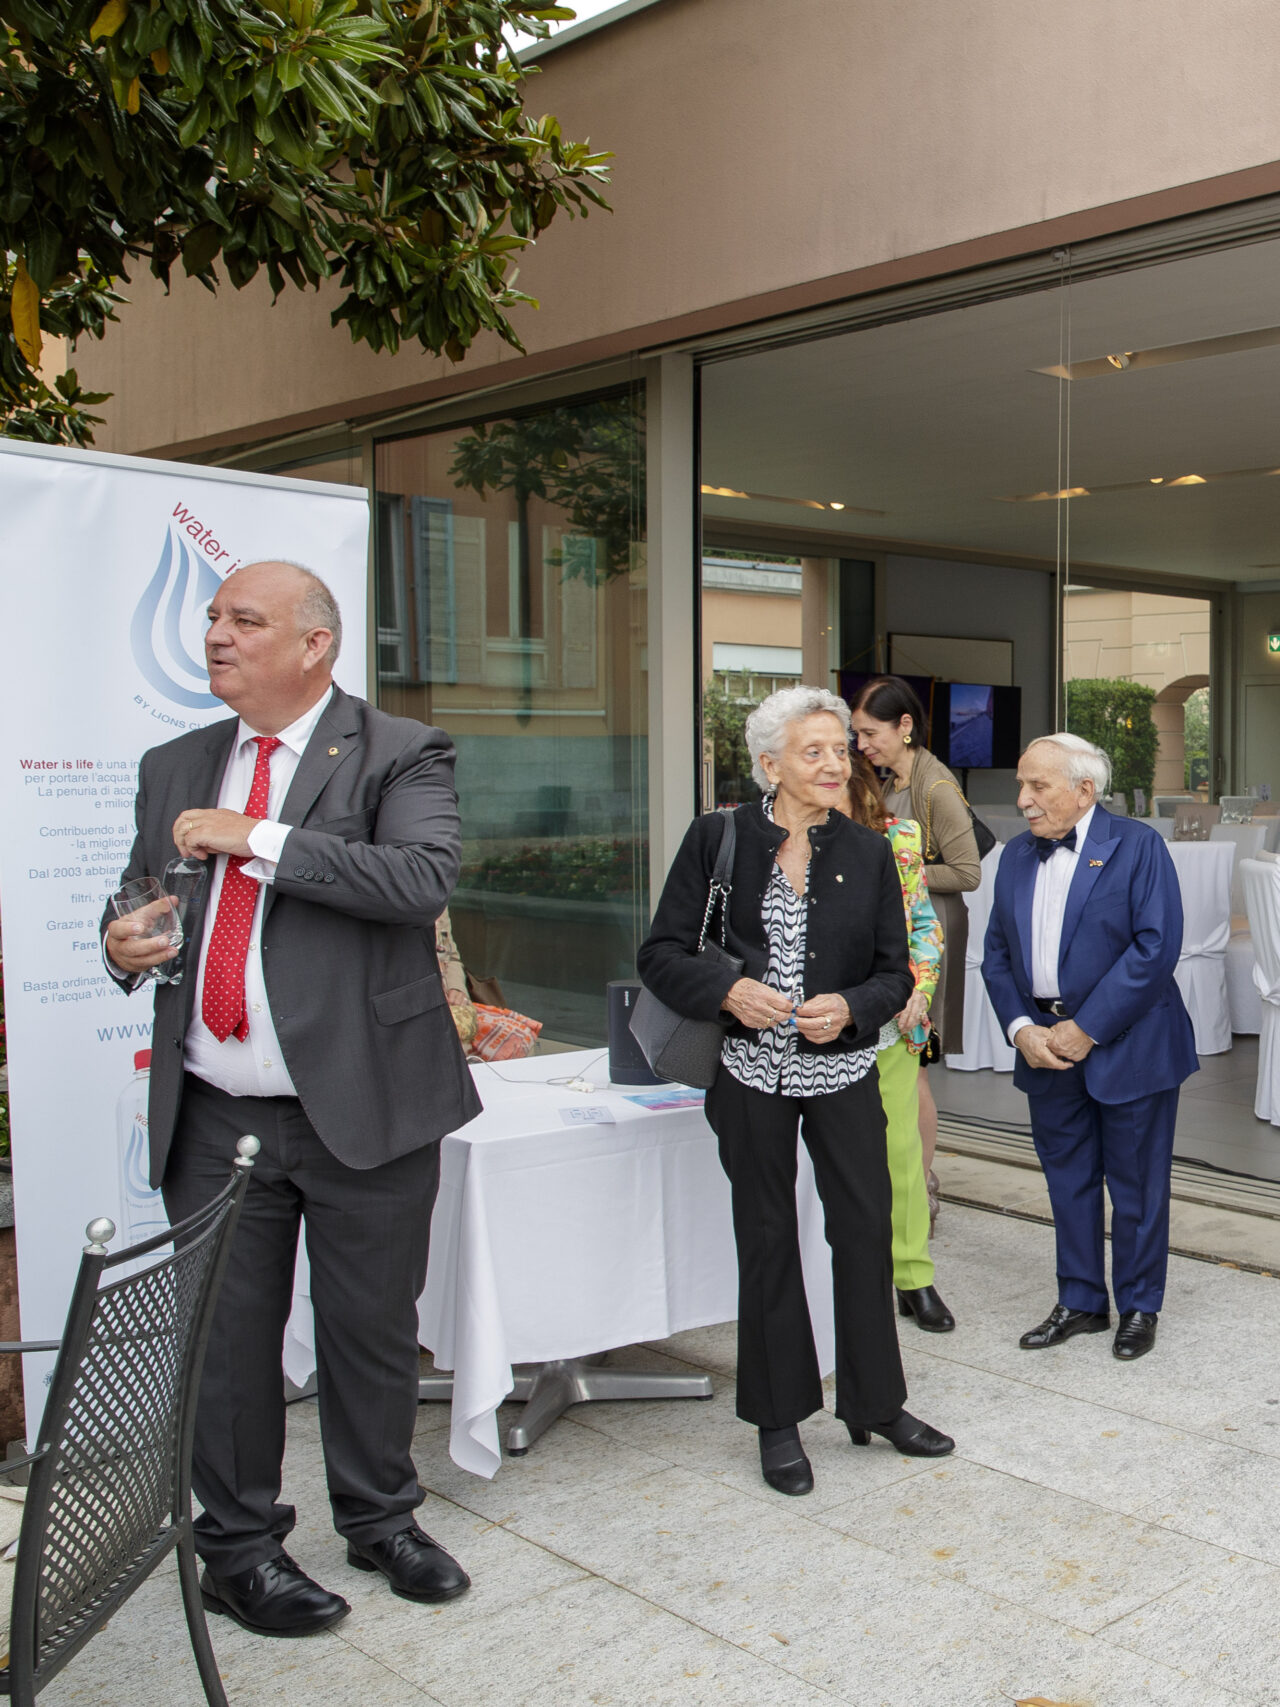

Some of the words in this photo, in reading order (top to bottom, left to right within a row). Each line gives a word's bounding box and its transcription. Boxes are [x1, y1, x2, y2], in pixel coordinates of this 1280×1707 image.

[172, 501, 230, 561] water
[134, 694, 150, 709] BY
[151, 708, 186, 729] LIONS
[20, 759, 58, 770] Water
[62, 759, 73, 770] is
[76, 759, 94, 770] life
[106, 761, 127, 769] una
[24, 775, 45, 786] per
[49, 774, 89, 785] portare
[38, 786, 53, 797] La
[56, 786, 98, 799] penuria
[101, 785, 110, 796] di
[94, 801, 102, 809] e
[39, 826, 115, 837] Contribuendo
[118, 824, 128, 835] al
[89, 837, 132, 850] migliore
[28, 869, 50, 879] Dal
[53, 867, 82, 878] 2003
[46, 919, 84, 931] Grazie
[87, 919, 94, 928] a
[72, 941, 98, 951] Fare
[23, 981, 59, 993] Basta
[62, 976, 107, 988] ordinare
[40, 995, 48, 1004] e
[95, 987, 106, 998] Vi
